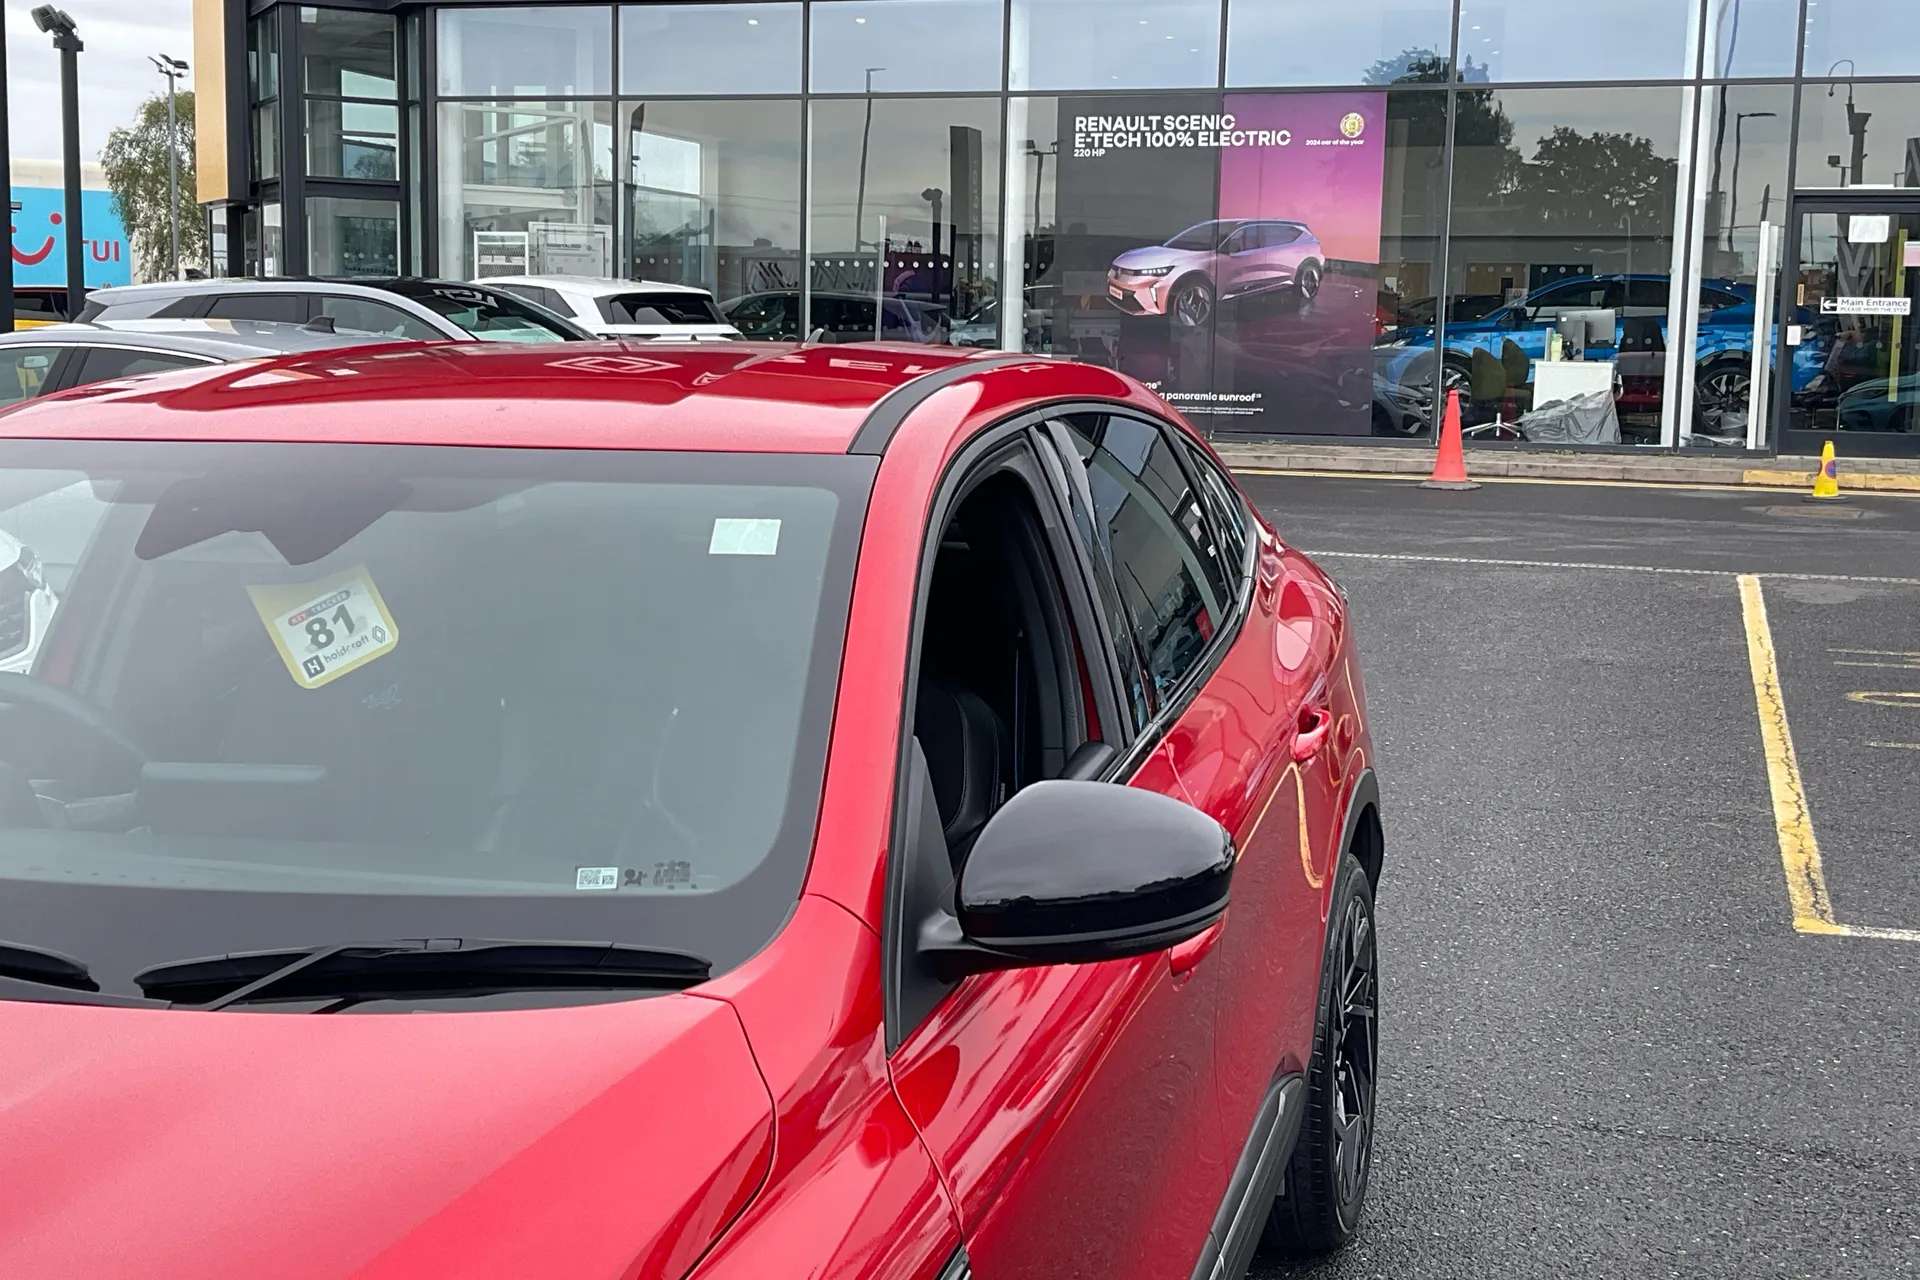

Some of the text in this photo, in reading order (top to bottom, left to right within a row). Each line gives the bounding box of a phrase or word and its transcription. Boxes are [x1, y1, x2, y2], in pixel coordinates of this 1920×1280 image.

[1075, 114, 1236, 132] RENAULT SCENIC
[1074, 129, 1292, 148] E-TECH 100% ELECTRIC
[1350, 139, 1364, 147] year
[1073, 148, 1106, 157] 220 HP
[82, 240, 120, 262] UI
[1866, 299, 1908, 307] Entrance
[1166, 391, 1217, 402] panoramic
[305, 604, 355, 650] 81
